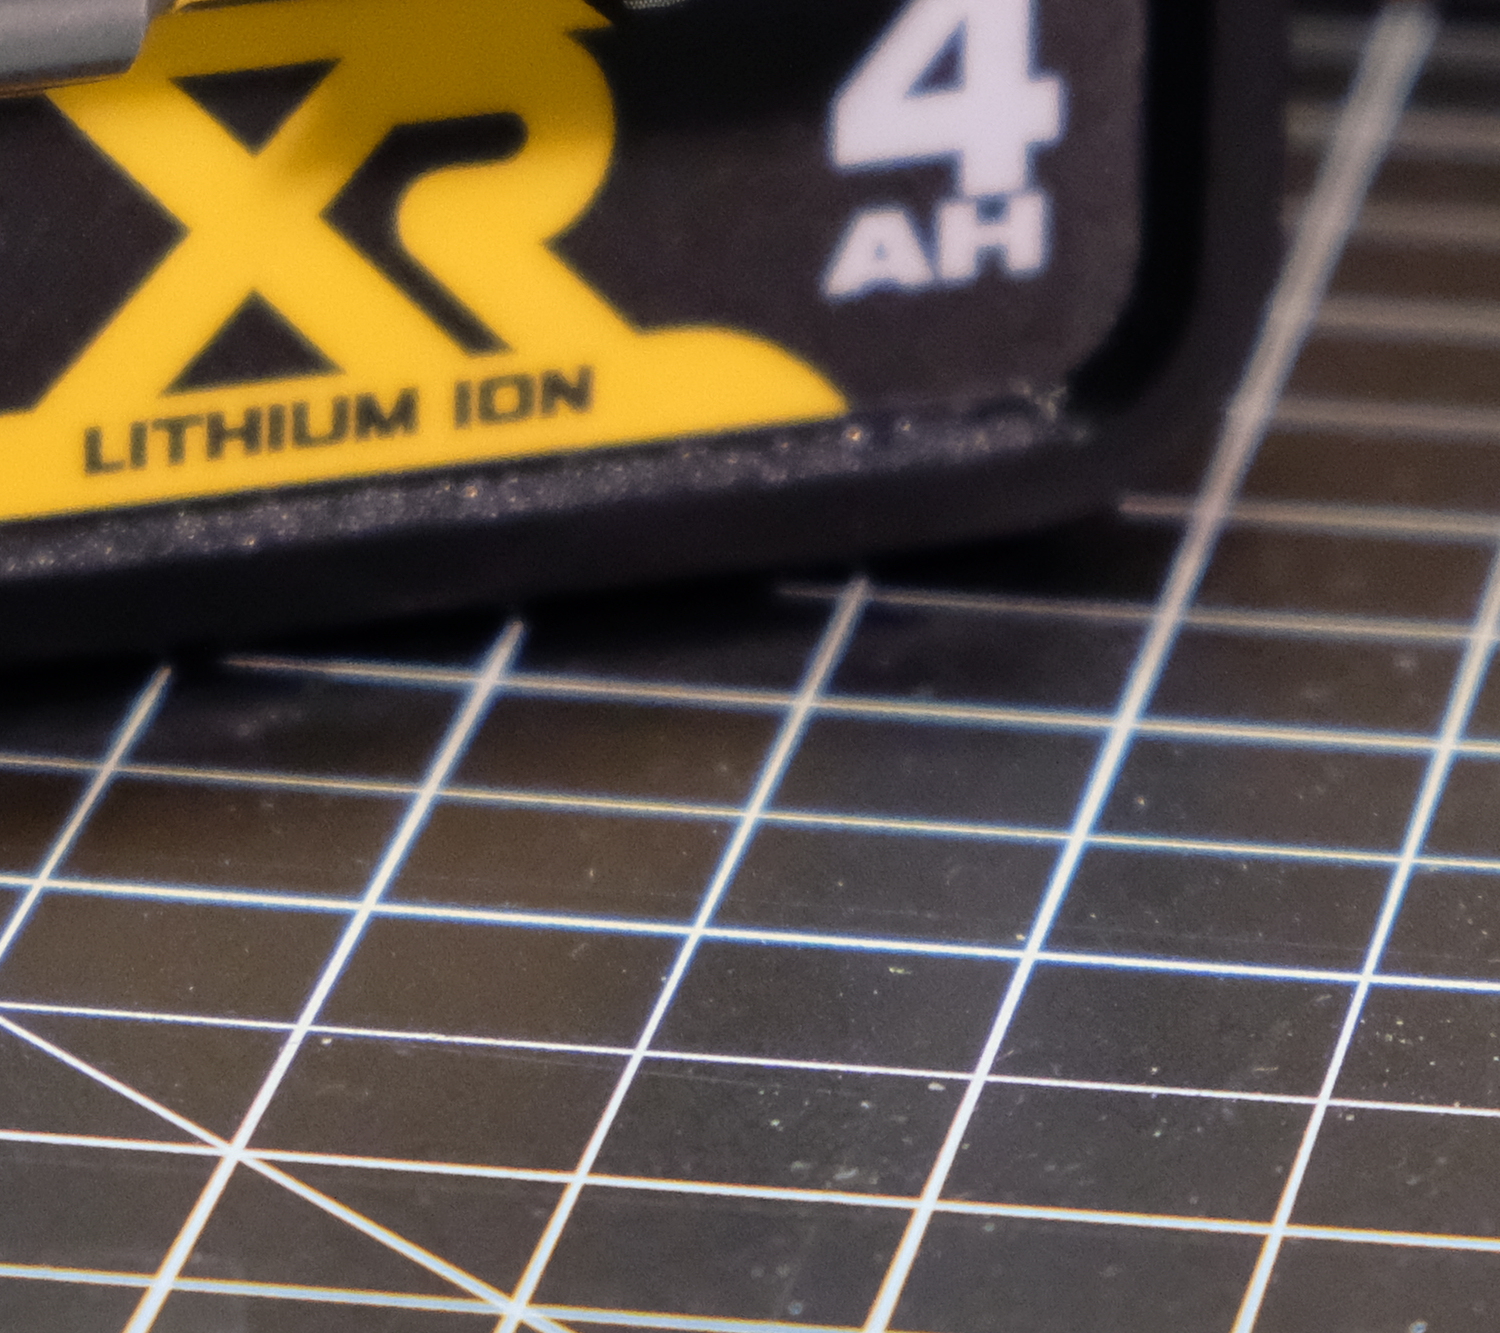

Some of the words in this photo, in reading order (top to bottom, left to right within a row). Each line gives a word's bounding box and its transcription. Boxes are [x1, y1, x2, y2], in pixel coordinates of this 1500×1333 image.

[822, 191, 1050, 299] AH
[83, 386, 420, 476] LITHIUM
[453, 364, 596, 430] ION
